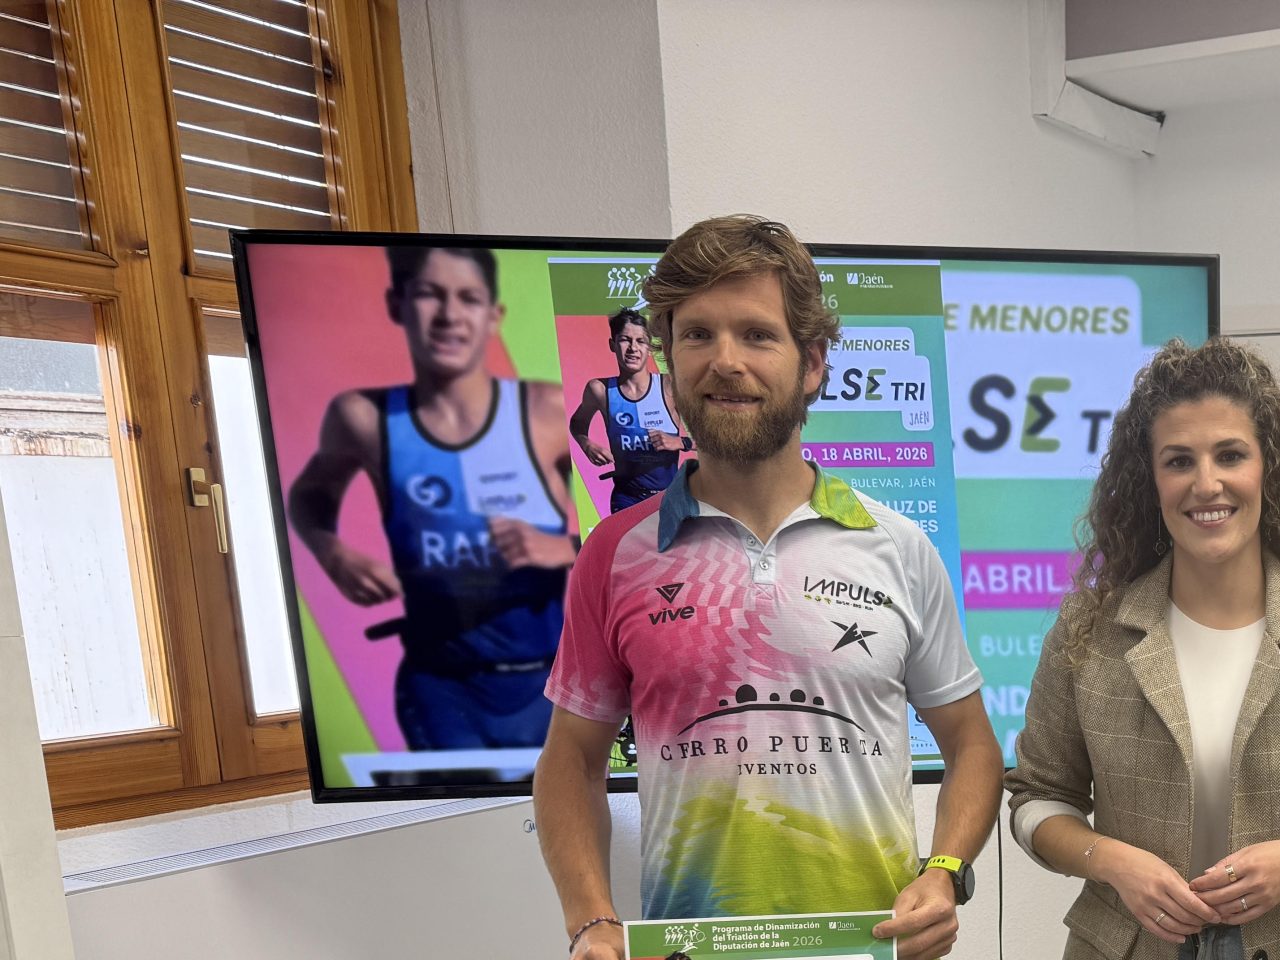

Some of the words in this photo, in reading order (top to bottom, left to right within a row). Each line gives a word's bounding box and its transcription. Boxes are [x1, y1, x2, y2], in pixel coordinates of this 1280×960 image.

[859, 272, 884, 284] Jaén
[969, 304, 1130, 334] MENORES
[842, 339, 910, 351] MENORES
[891, 382, 925, 401] TRI
[909, 410, 930, 426] JAÉN
[822, 448, 838, 461] 18
[843, 447, 892, 462] ABRIL,
[895, 447, 928, 461] 2026
[851, 478, 904, 489] BULEVAR,
[908, 477, 936, 488] JAÉN
[918, 500, 937, 514] DE
[648, 605, 695, 626] vive
[979, 634, 1041, 657] BULE
[769, 736, 883, 757] PUERTA
[712, 925, 752, 934] Programa
[754, 923, 764, 931] de
[766, 922, 820, 931] Dinamización
[712, 933, 723, 942] del
[726, 932, 758, 941] Triatlón
[713, 941, 758, 951] Diputación
[760, 940, 770, 948] de
[771, 940, 790, 948] Jaén
[793, 935, 823, 947] 2026
